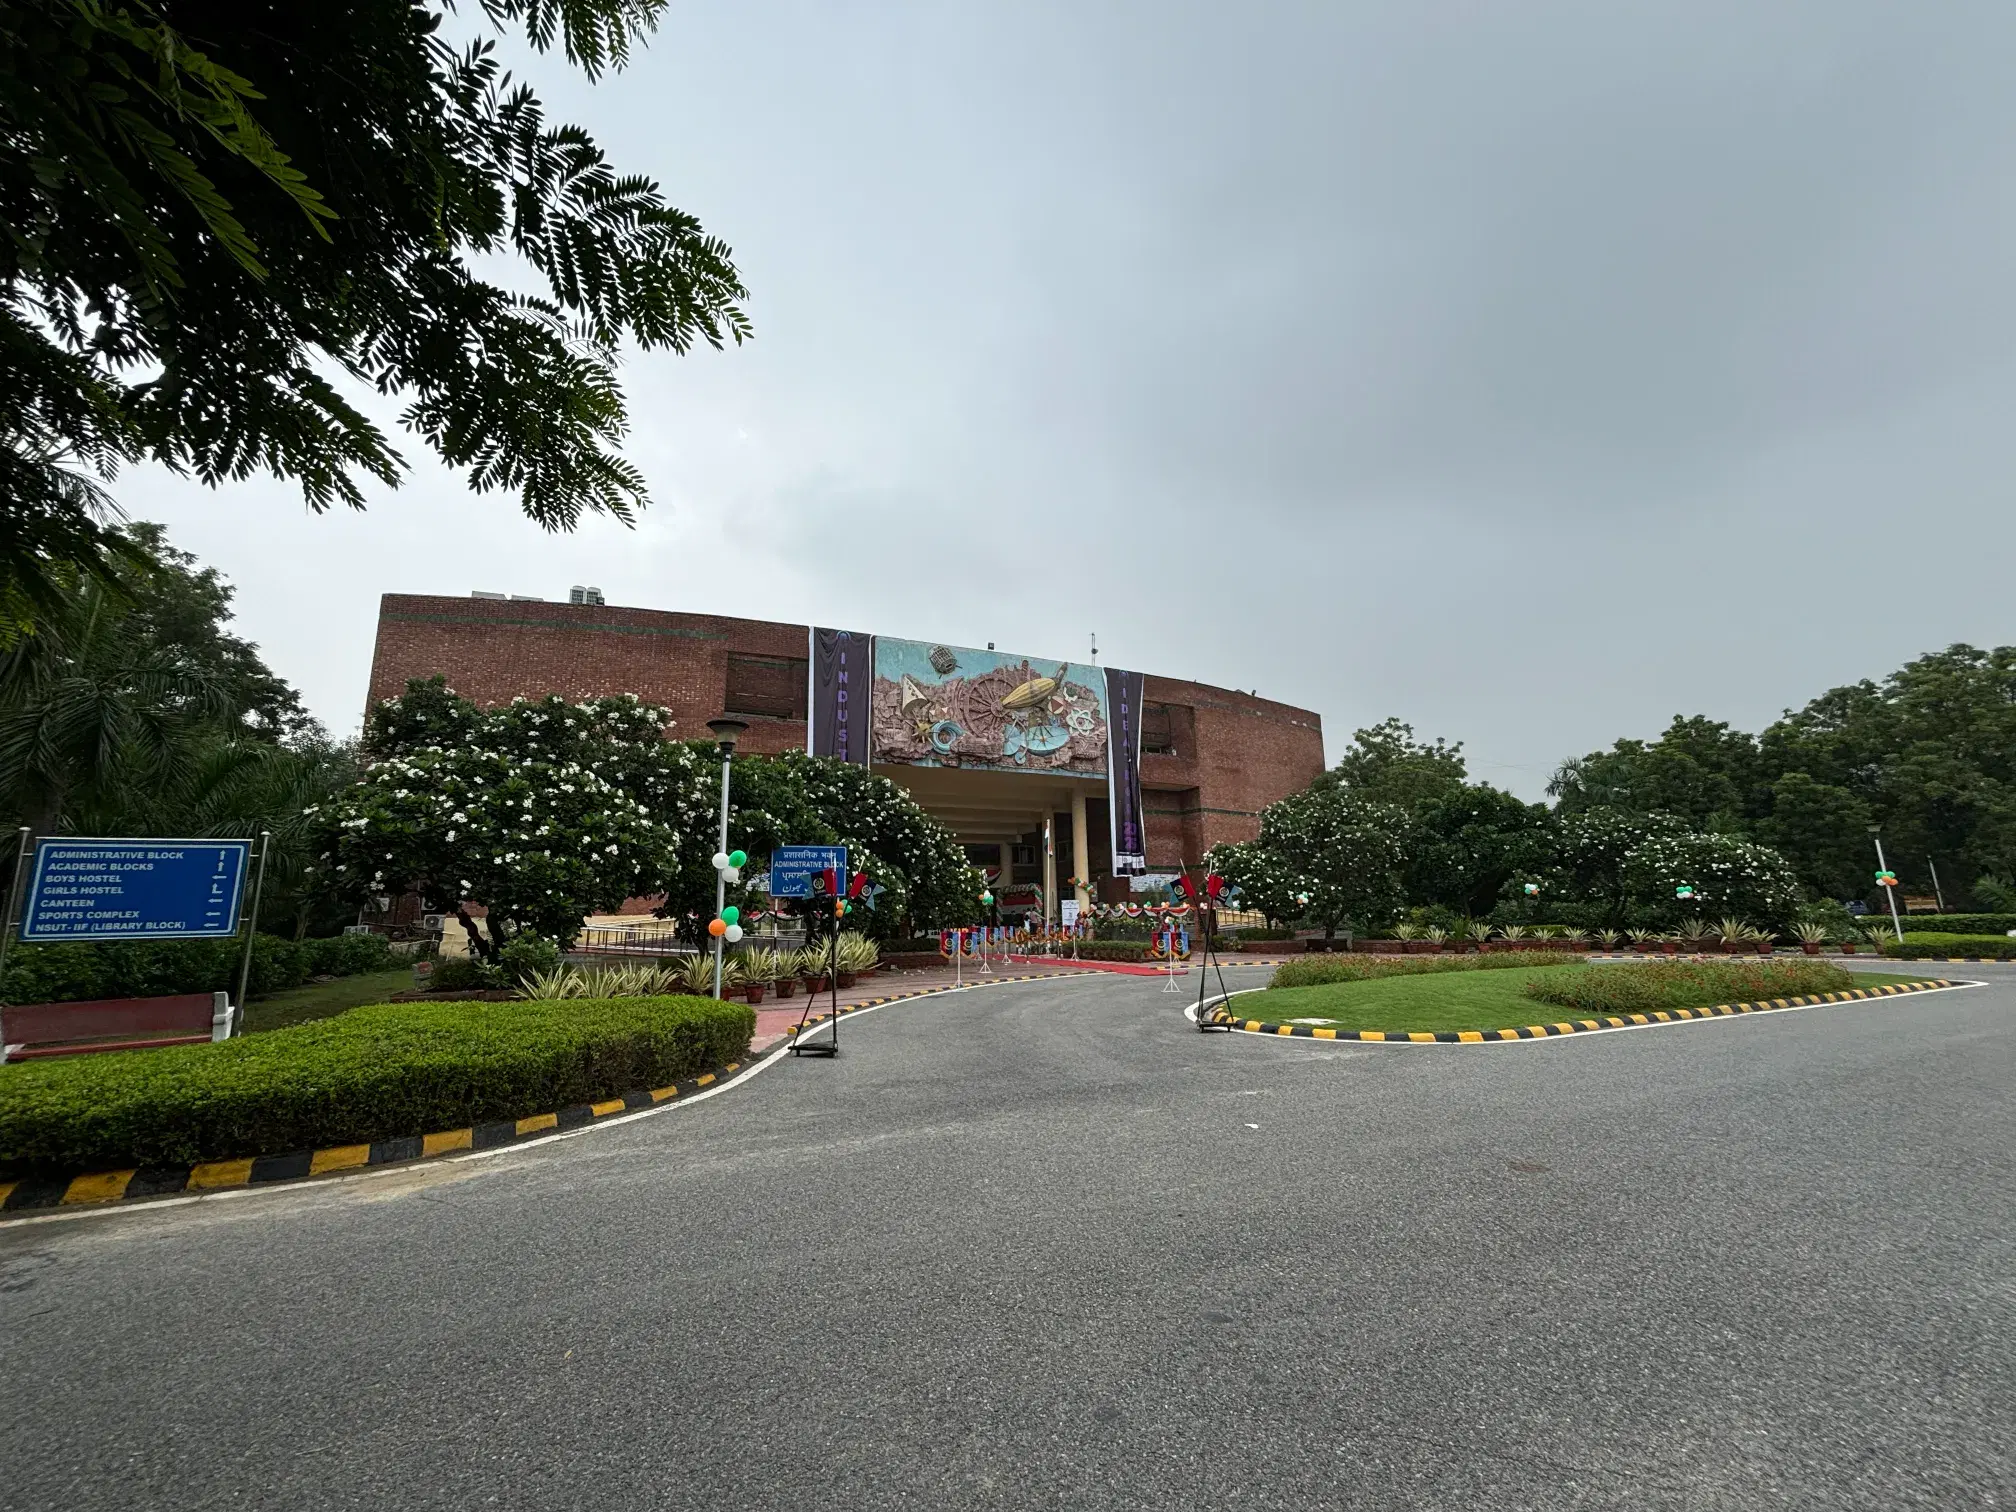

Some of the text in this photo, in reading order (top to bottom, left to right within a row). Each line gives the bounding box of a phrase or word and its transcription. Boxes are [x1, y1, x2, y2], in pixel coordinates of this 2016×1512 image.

[50, 851, 184, 860] ADMINISTRATIVE BLOCK
[783, 850, 818, 859] प्रशासनिक
[48, 863, 154, 871] ACADEMIC BLOCKS
[45, 875, 122, 883] BOYS HOSTEL
[43, 887, 77, 895] GIRLS
[40, 899, 95, 907] CANTEEN
[38, 911, 140, 920] SPORTS COMPLEX
[90, 922, 143, 932] (LIBRARY
[145, 921, 186, 930] BLOCK)
